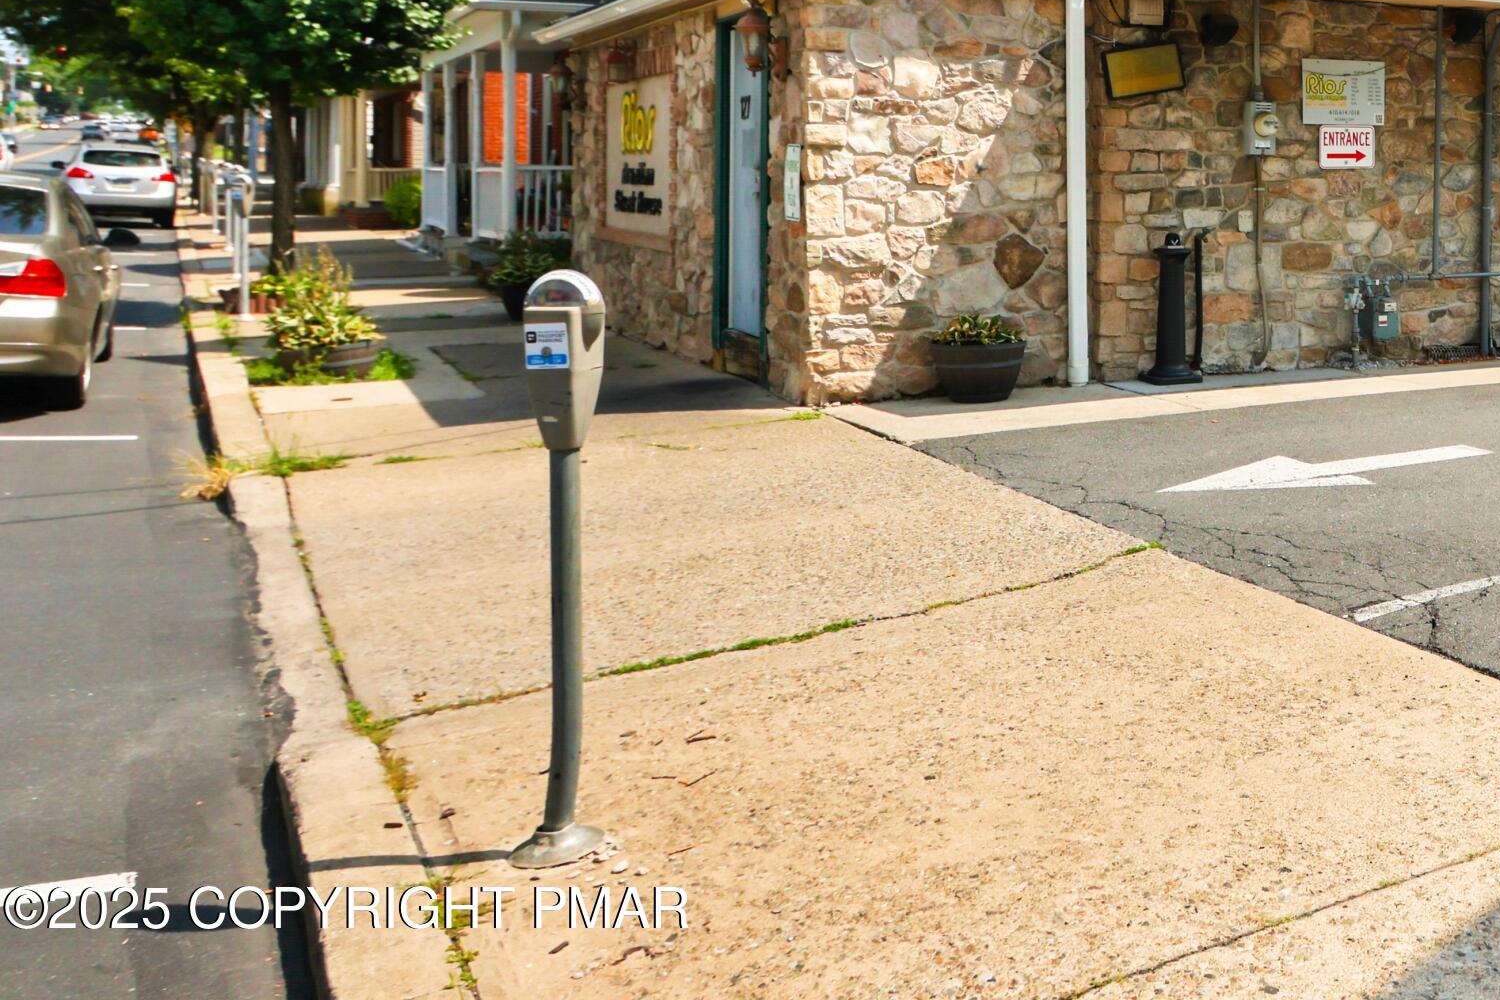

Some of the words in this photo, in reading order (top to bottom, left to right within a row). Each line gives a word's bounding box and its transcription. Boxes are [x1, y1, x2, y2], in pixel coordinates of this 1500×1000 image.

[1305, 72, 1347, 95] Rios
[621, 89, 657, 154] Rios
[1323, 131, 1371, 147] ENTRANCE
